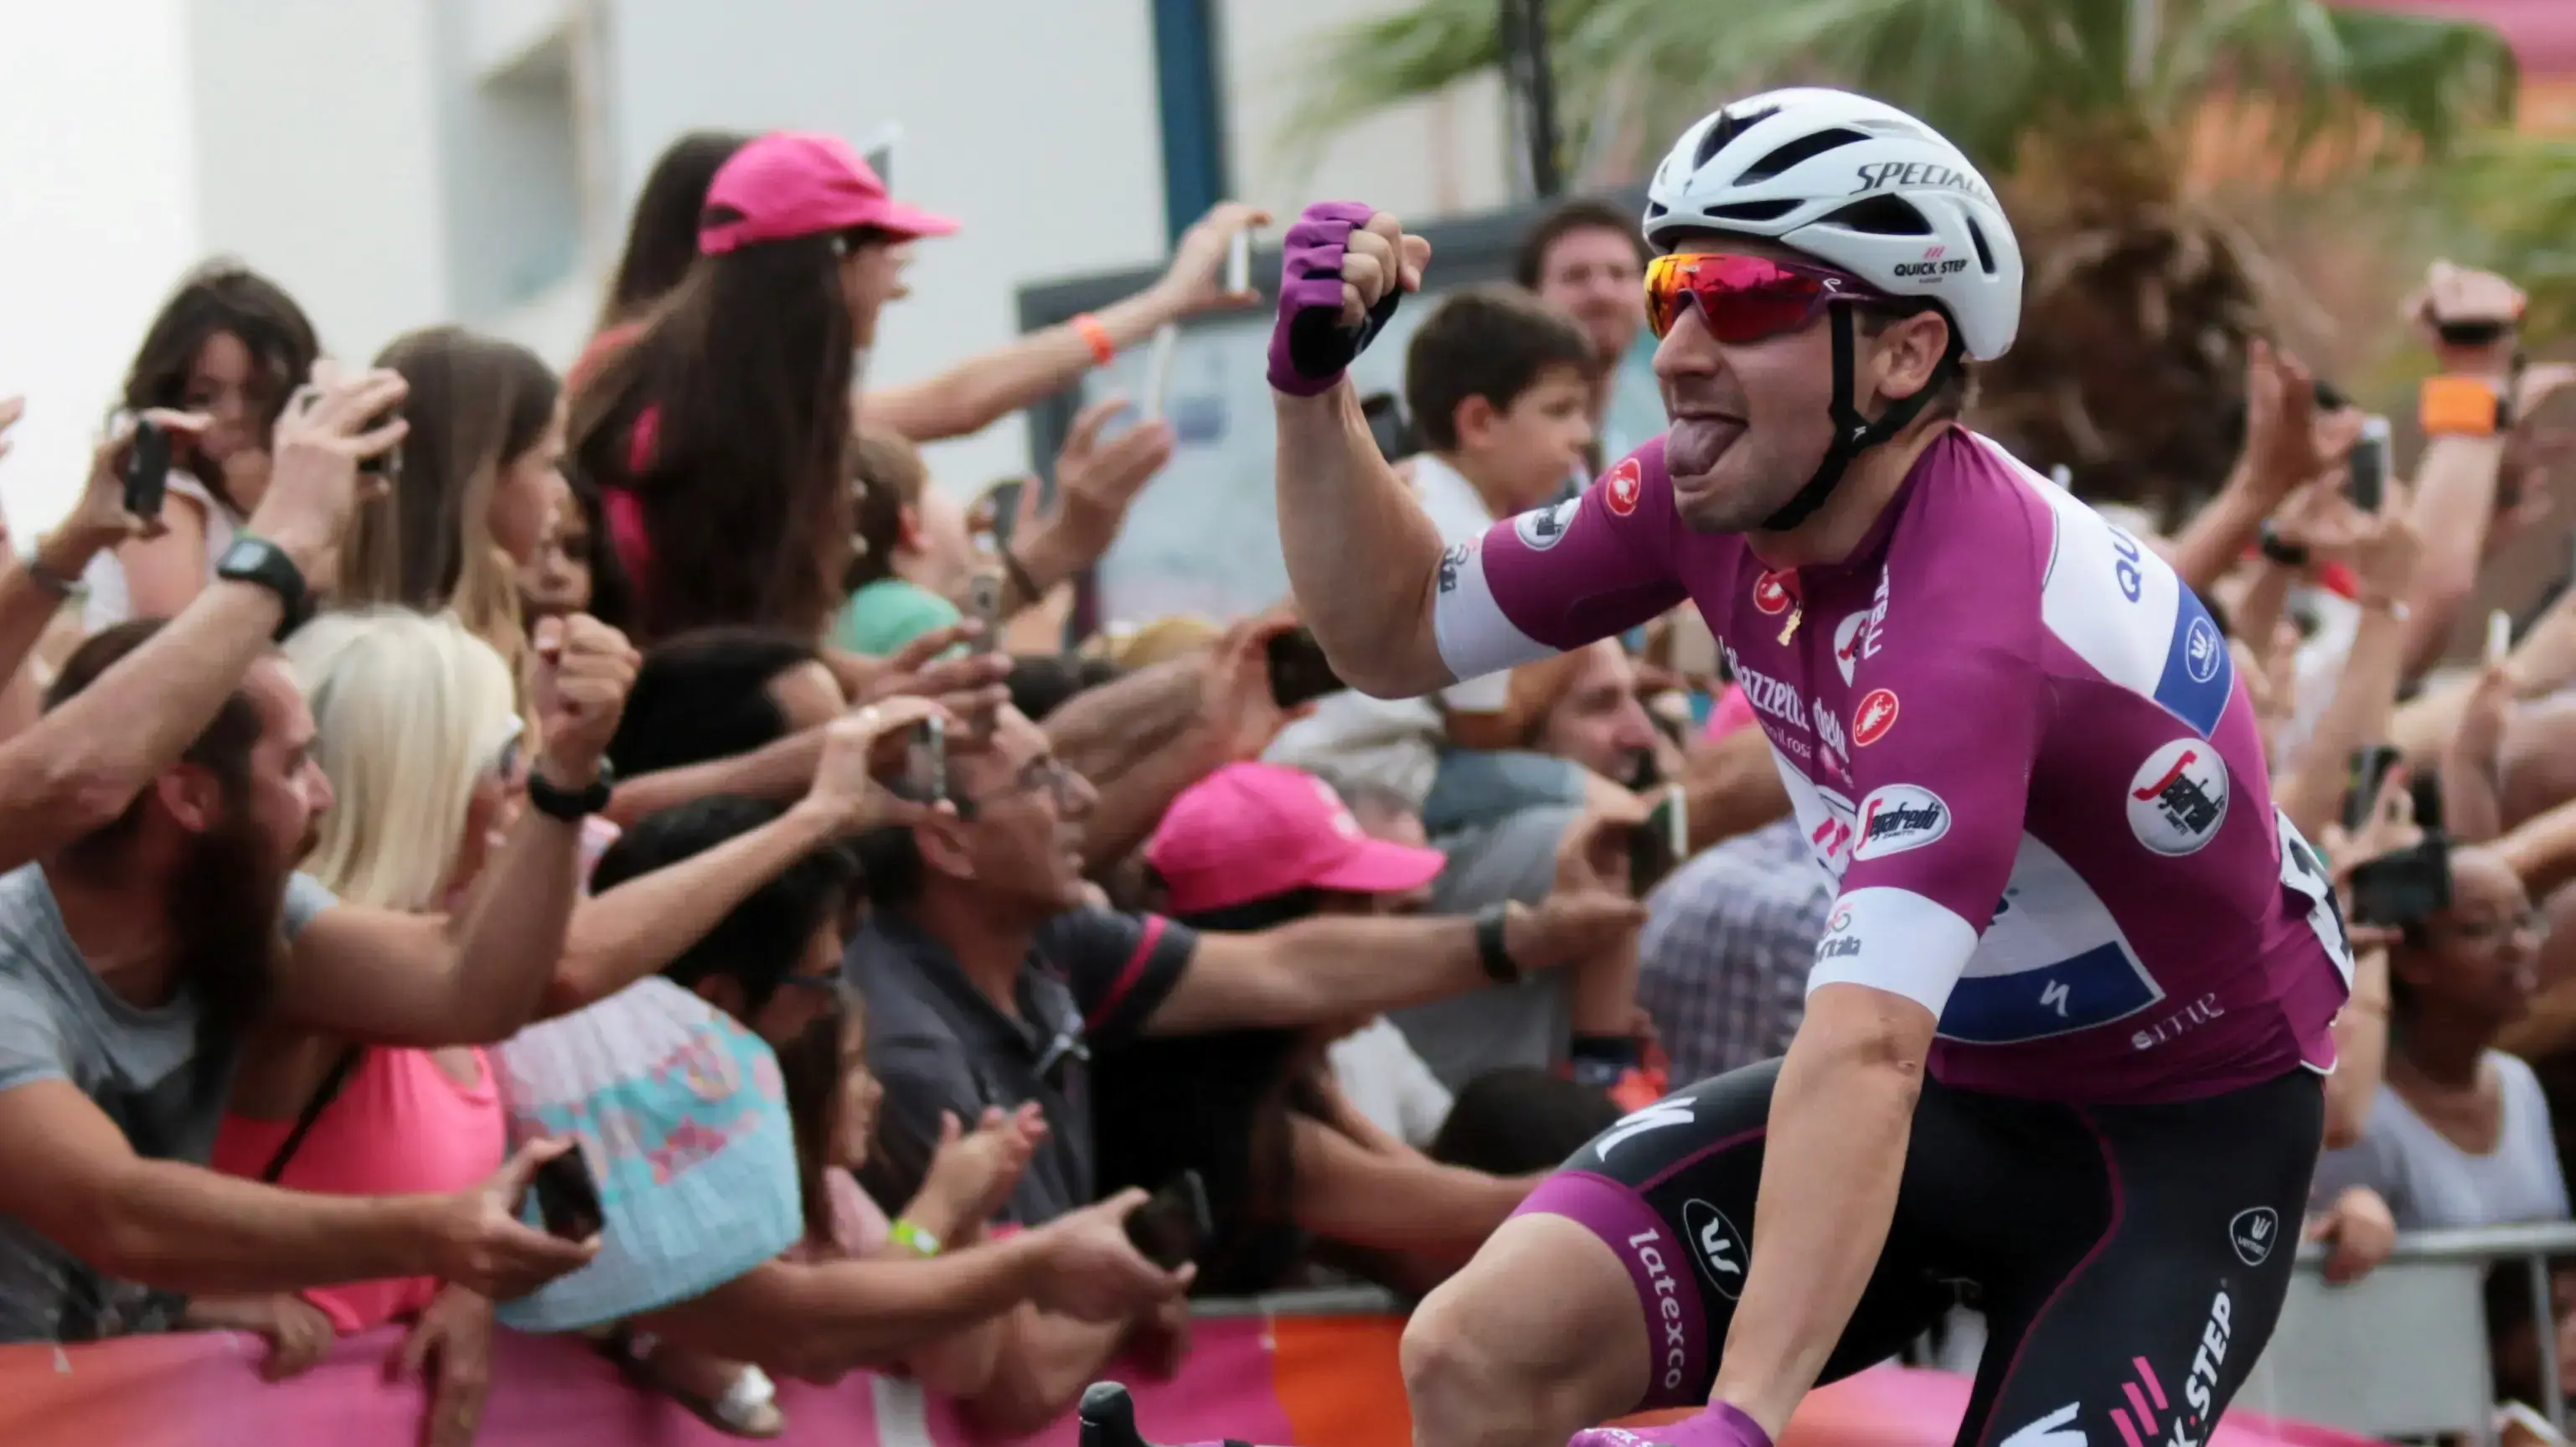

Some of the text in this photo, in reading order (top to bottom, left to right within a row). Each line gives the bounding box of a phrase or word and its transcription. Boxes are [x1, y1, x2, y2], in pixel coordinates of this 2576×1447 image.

[1893, 259, 1968, 276] QUICK STEP
[1629, 1227, 1685, 1389] latexco
